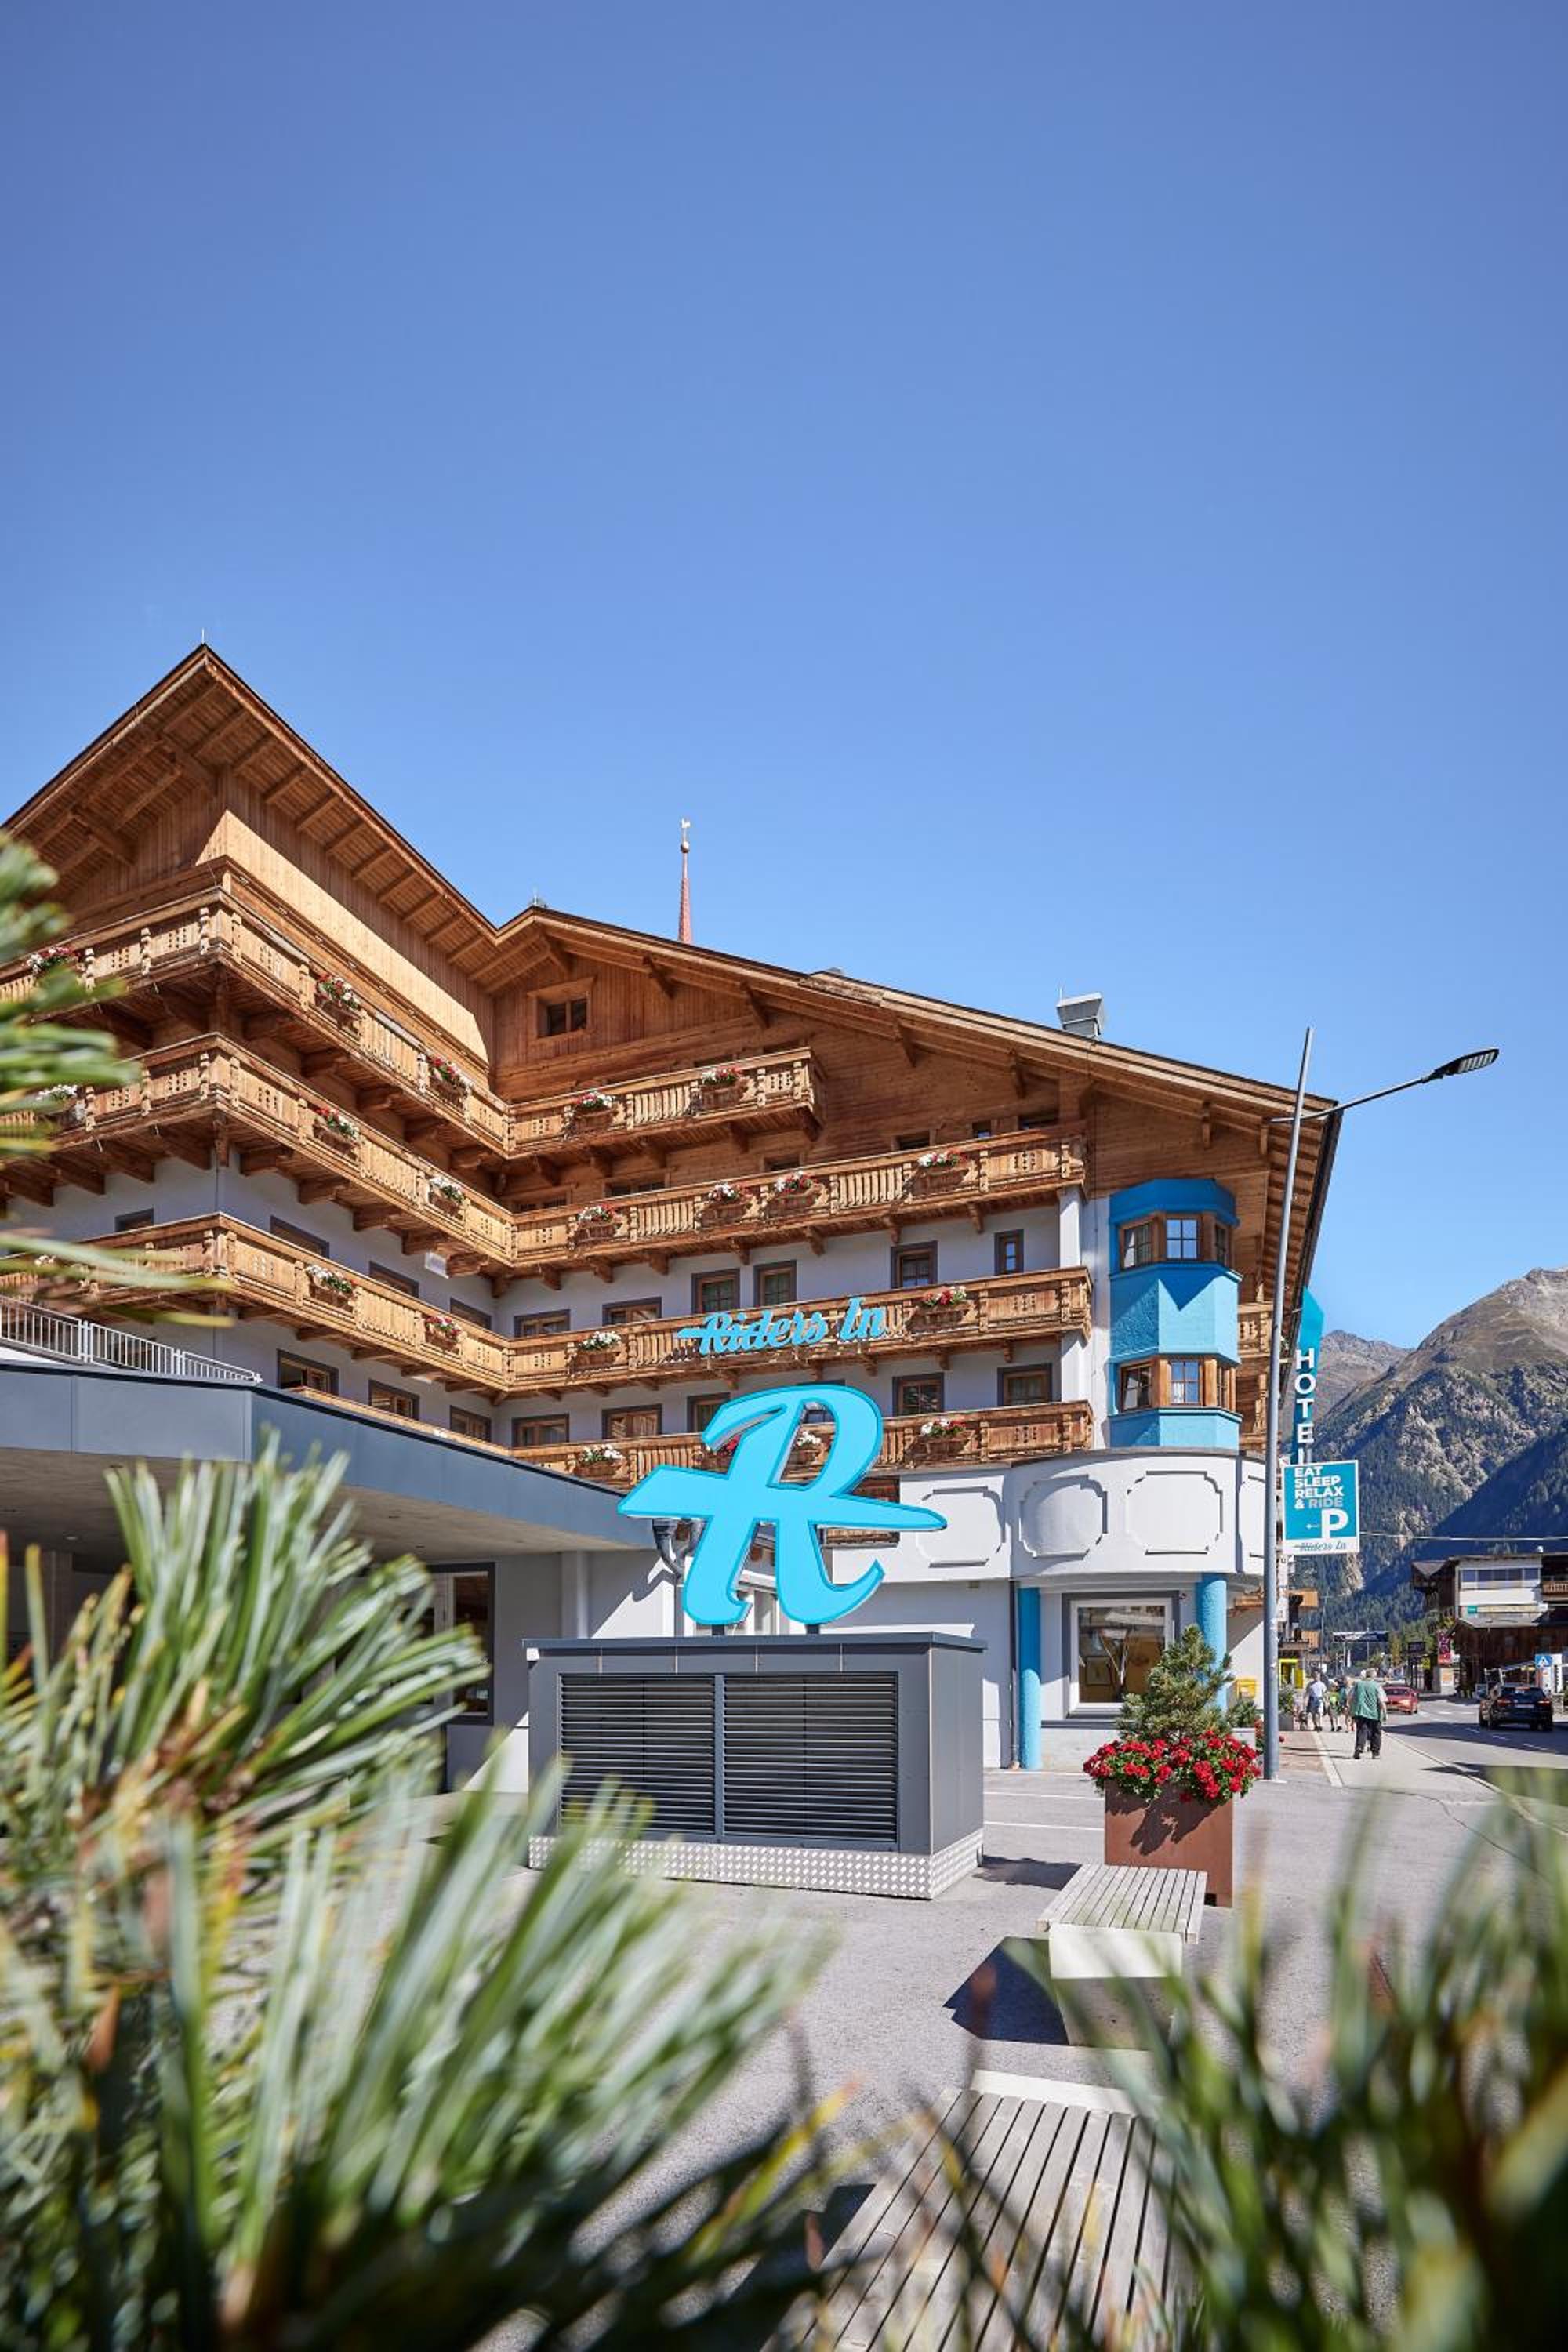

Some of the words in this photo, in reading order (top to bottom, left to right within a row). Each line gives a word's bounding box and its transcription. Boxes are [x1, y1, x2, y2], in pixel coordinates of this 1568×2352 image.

[677, 1311, 829, 1356] Riders
[840, 1297, 887, 1341] In
[1294, 1465, 1323, 1477] EAT
[1294, 1475, 1341, 1489] SLEEP
[1294, 1486, 1344, 1499] RELAX
[618, 1384, 948, 1626] R
[1294, 1499, 1305, 1509] &
[1308, 1497, 1343, 1508] RIDE
[1321, 1508, 1348, 1540] P
